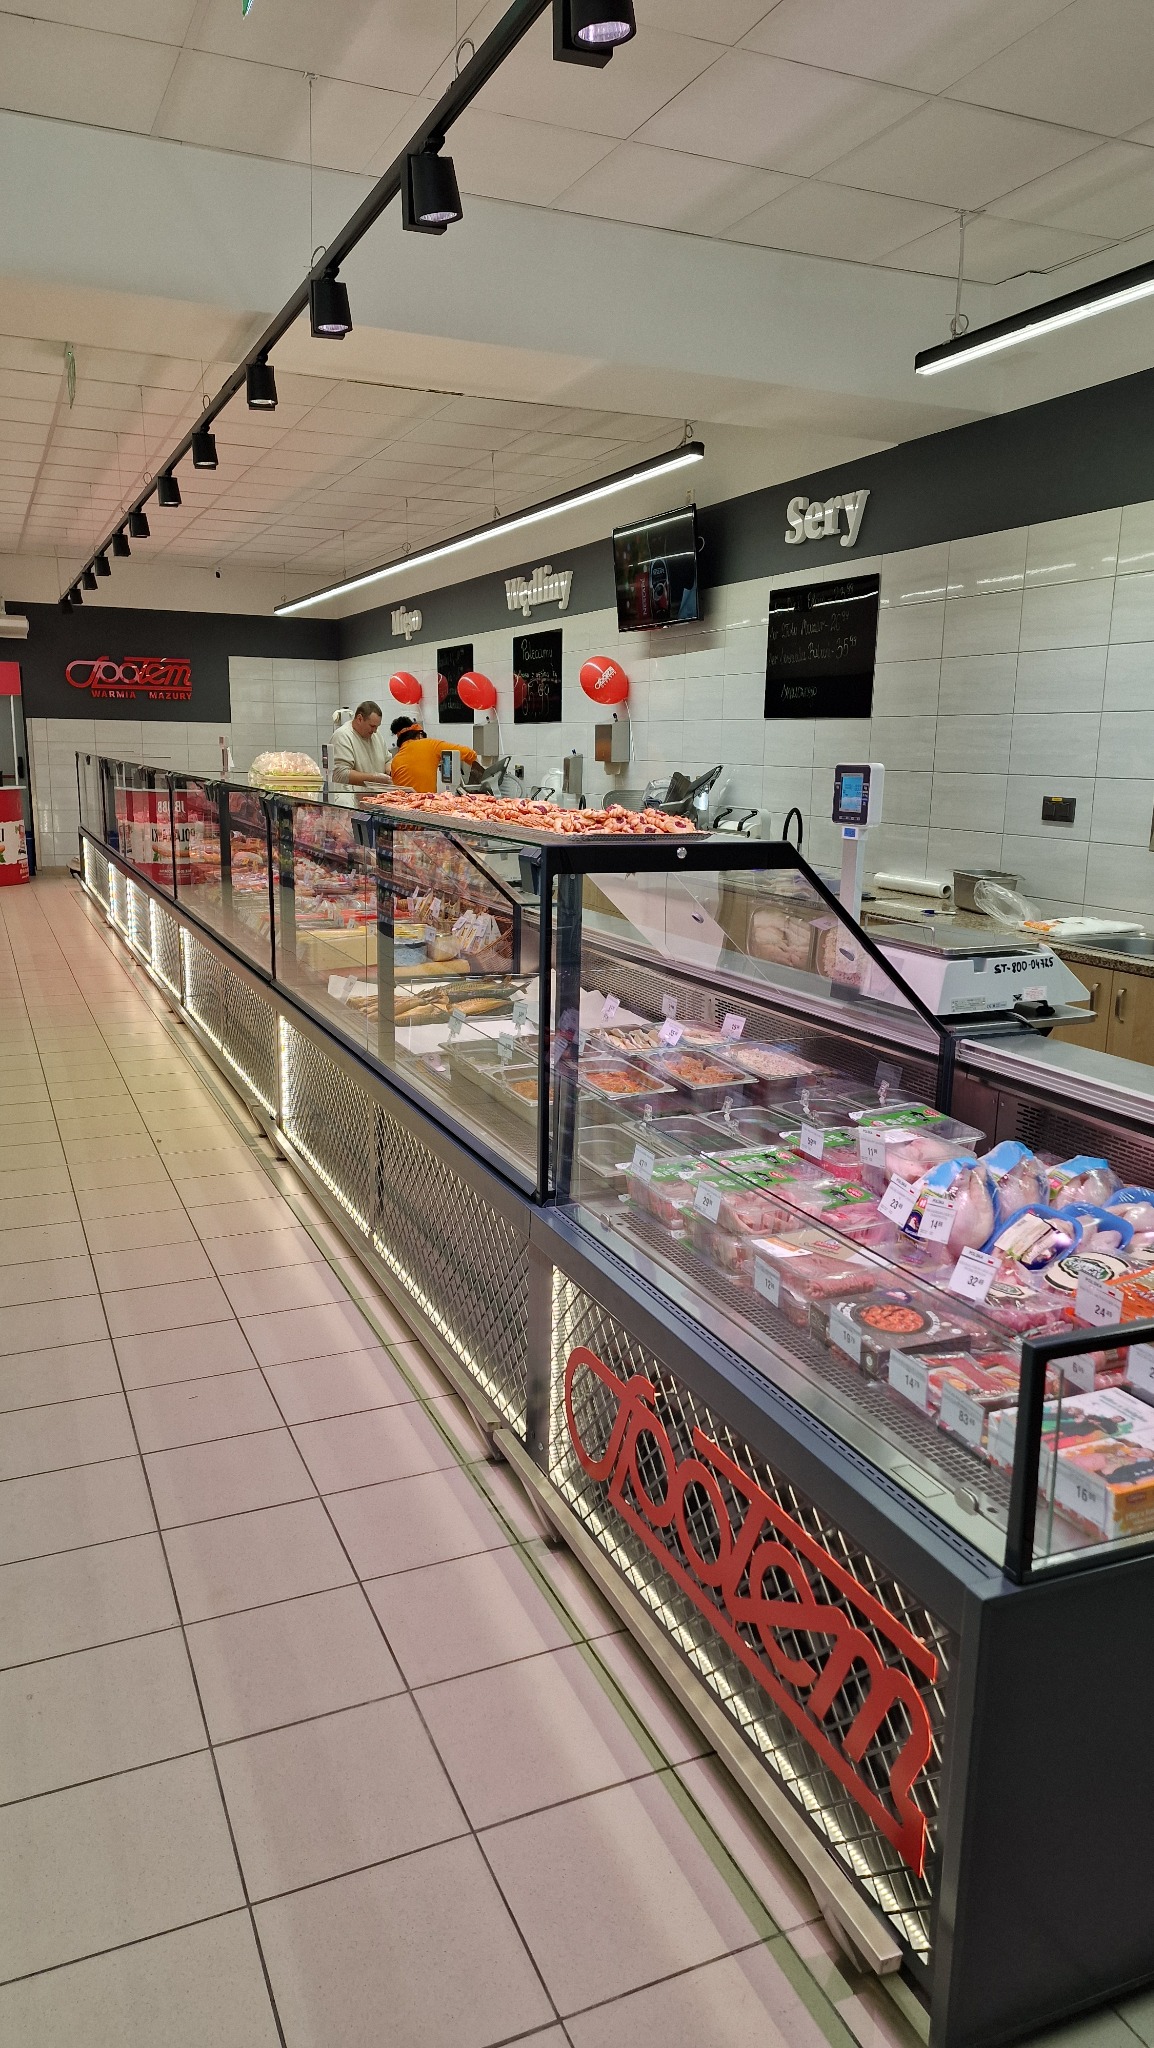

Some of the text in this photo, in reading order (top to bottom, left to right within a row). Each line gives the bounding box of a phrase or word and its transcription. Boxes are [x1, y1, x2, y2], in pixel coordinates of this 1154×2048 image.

[784, 489, 871, 547] Sery
[505, 565, 574, 617] Wędliny
[91, 690, 192, 700] WARMIA MAZURY
